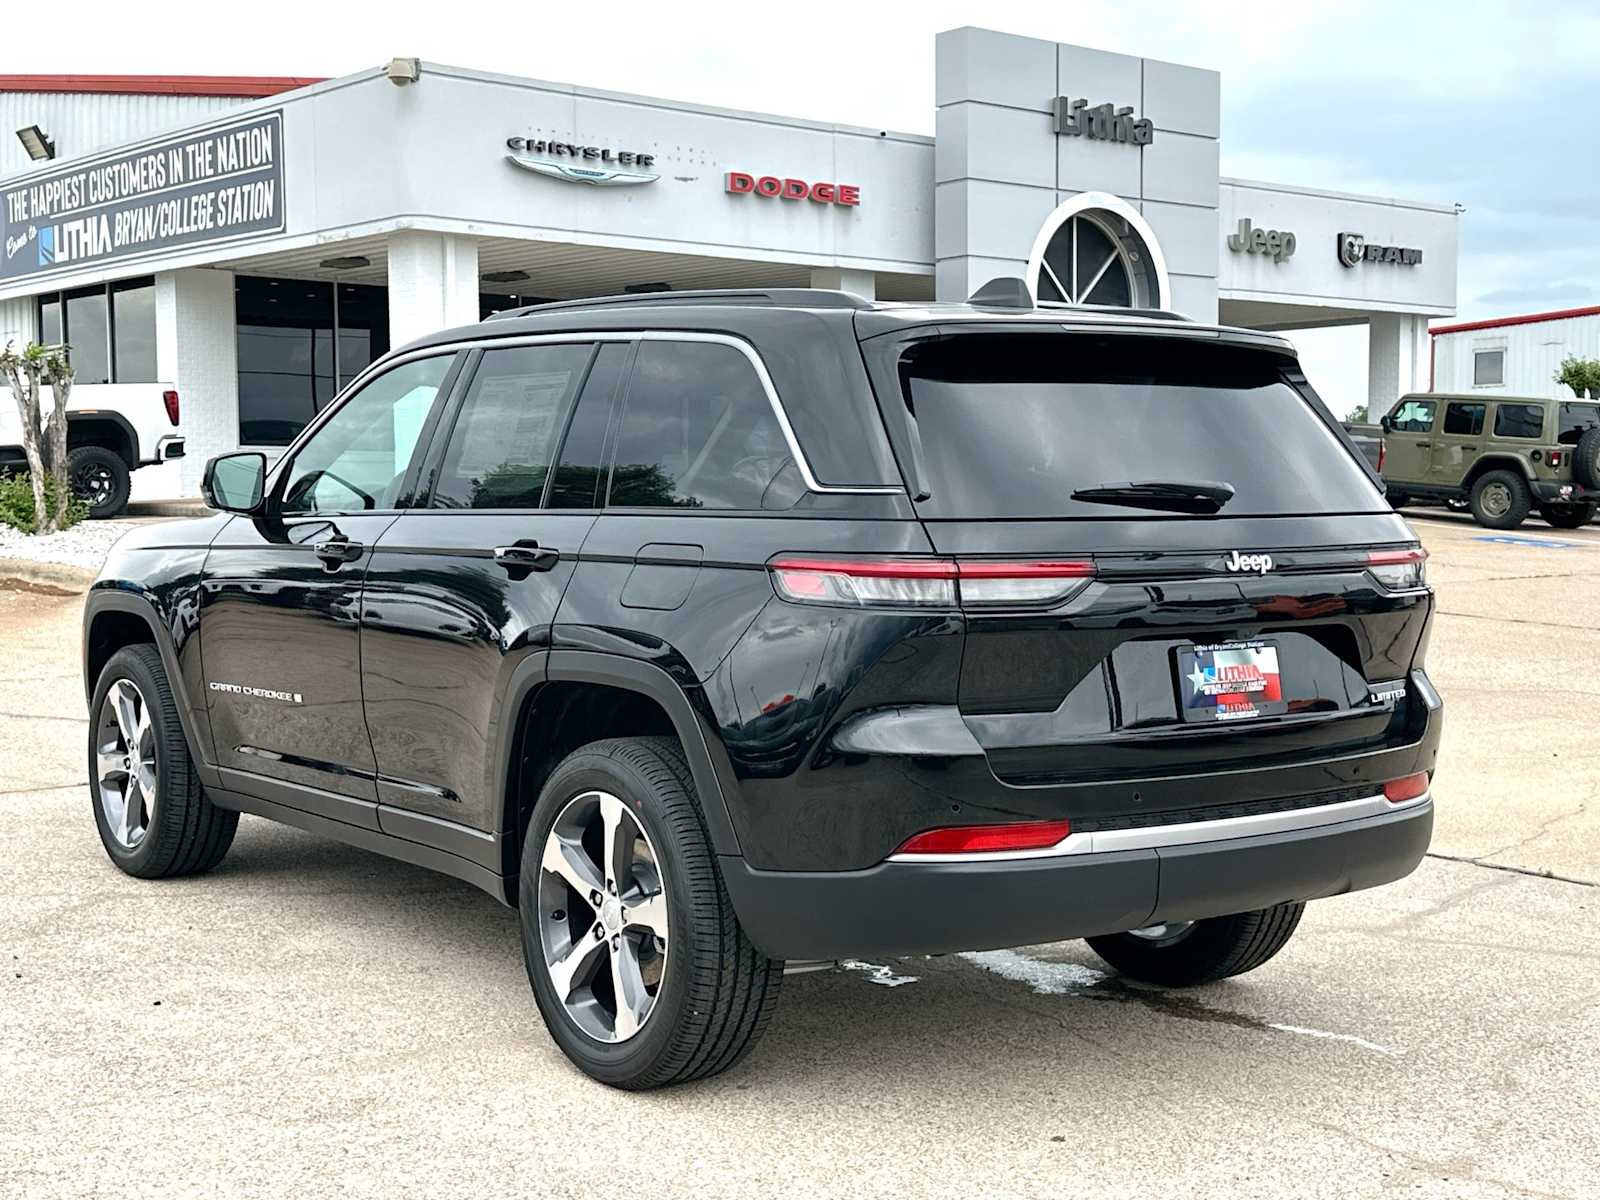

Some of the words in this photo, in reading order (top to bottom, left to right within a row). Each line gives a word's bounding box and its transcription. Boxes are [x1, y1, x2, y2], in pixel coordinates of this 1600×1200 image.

[1052, 95, 1154, 145] Lithia
[506, 136, 655, 167] CHRYSLER
[7, 190, 29, 223] THE
[31, 173, 87, 218] HAPPIEST
[89, 152, 166, 202] CUSTOMERS
[169, 148, 184, 185] IN
[186, 139, 215, 180] THE
[217, 124, 273, 173] NATION
[725, 172, 860, 206] DODGE
[54, 214, 112, 263] LITHIA
[114, 191, 215, 247] BRYAN/COLLEGE
[217, 179, 274, 227] STATION
[1227, 217, 1296, 264] Jeep
[1365, 244, 1423, 266] RAM
[1226, 550, 1272, 574] Jeep
[1217, 664, 1262, 682] LITHIA
[210, 682, 242, 694] GRAND
[243, 687, 293, 701] CHEROKEE
